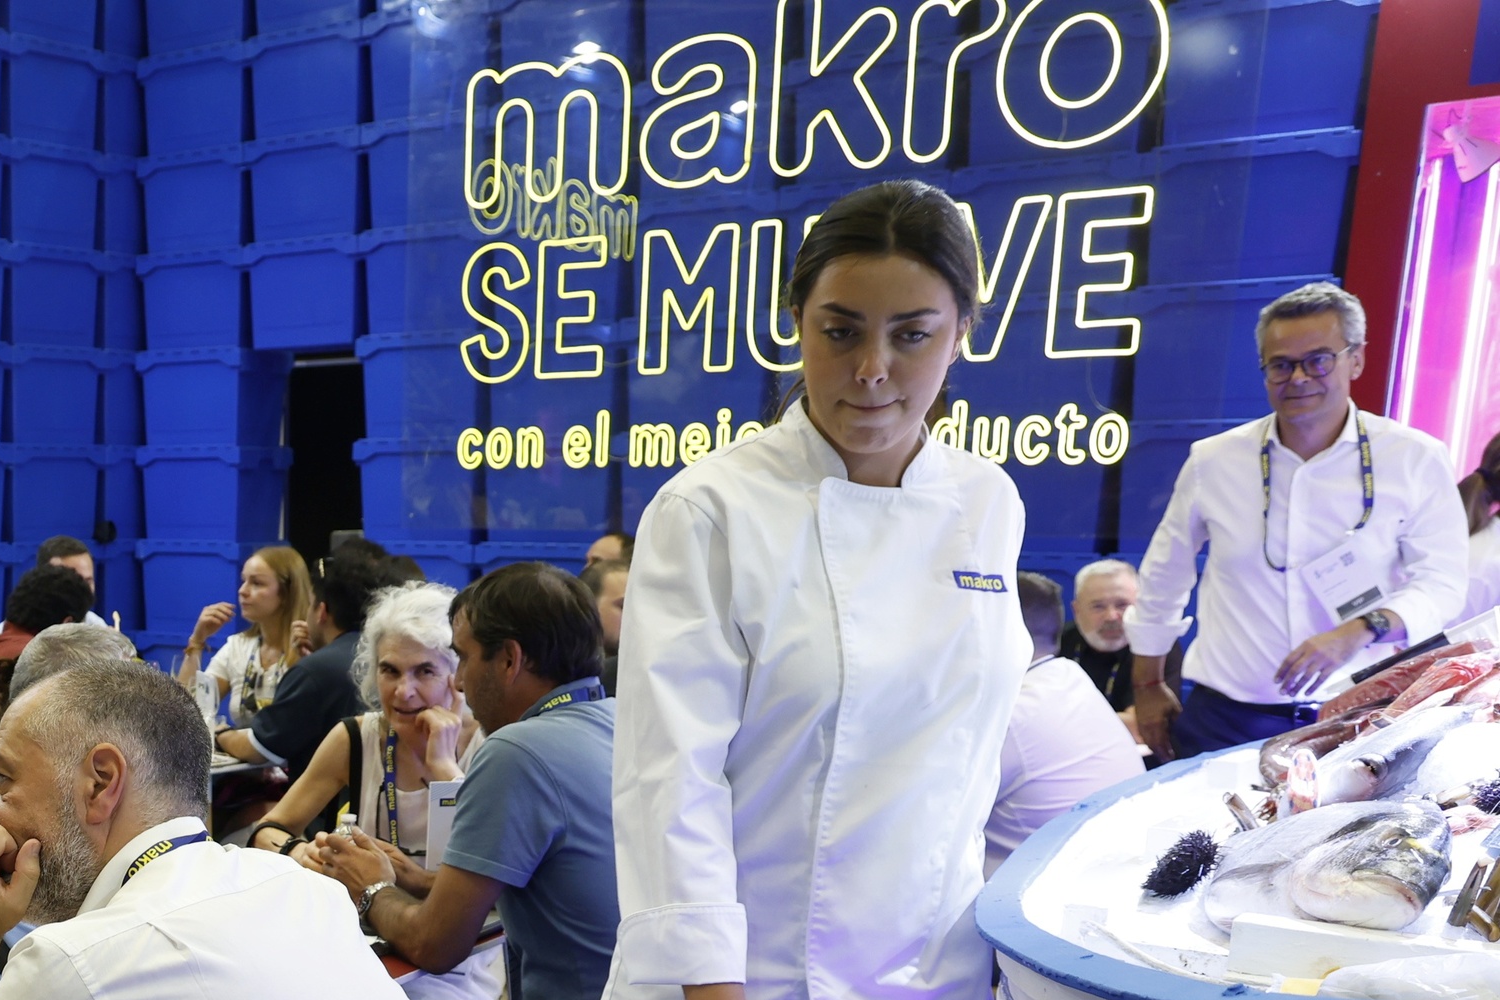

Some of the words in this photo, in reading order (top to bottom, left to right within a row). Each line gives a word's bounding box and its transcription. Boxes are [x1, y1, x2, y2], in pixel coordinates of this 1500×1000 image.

[463, 0, 1171, 212] makro
[459, 234, 608, 385] SE
[636, 184, 1156, 377] MUVE
[456, 416, 546, 471] con
[561, 408, 611, 470] el
[959, 575, 1003, 590] makro
[386, 744, 395, 774] makro
[386, 781, 396, 811] makro
[127, 839, 174, 878] makro
